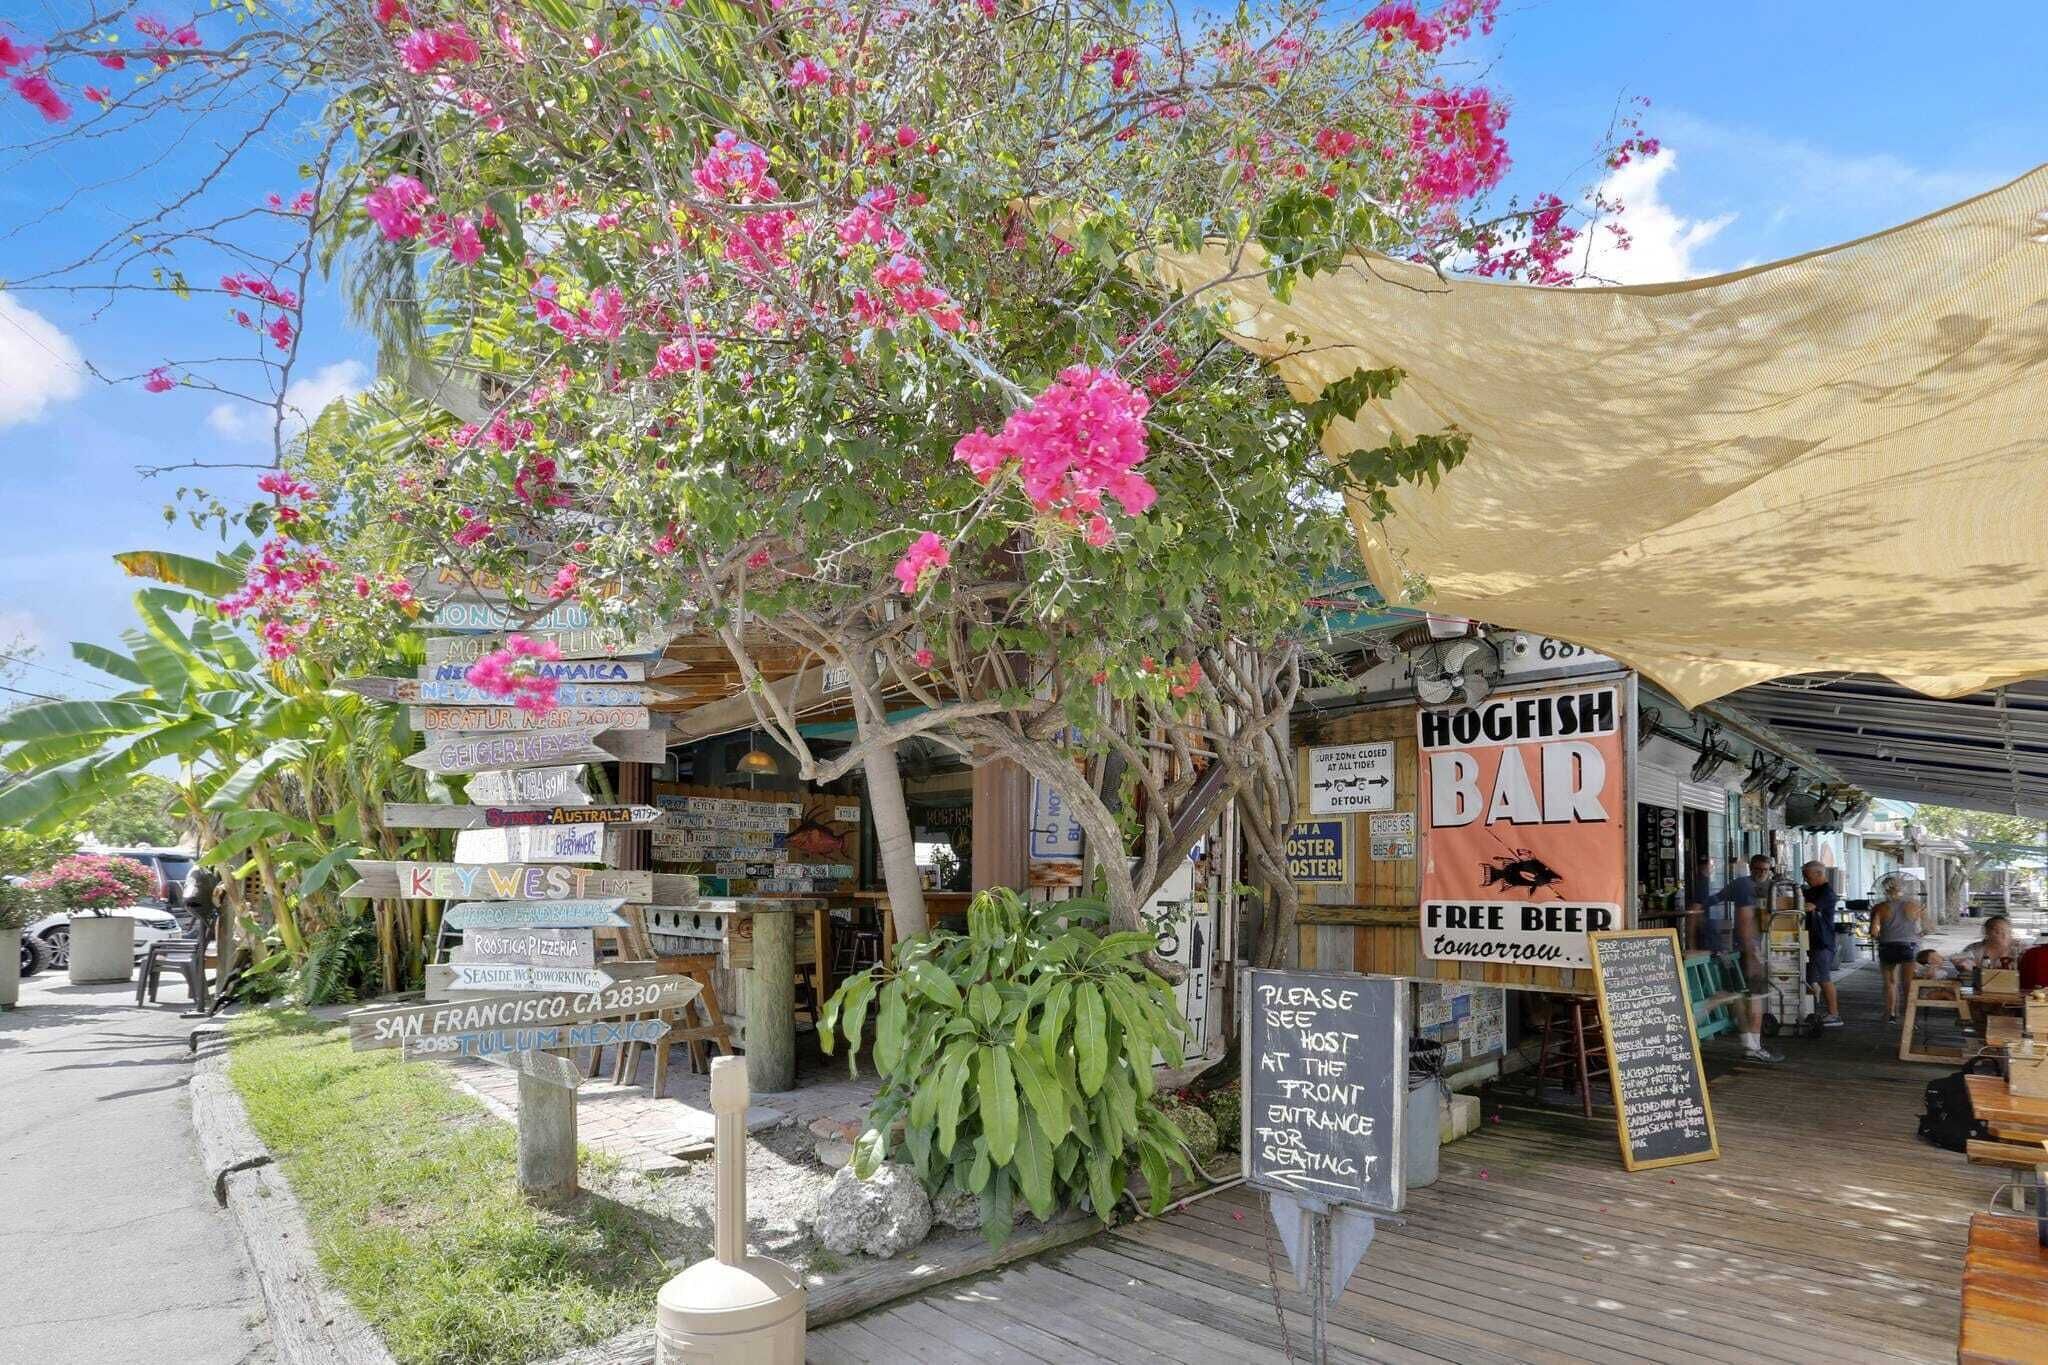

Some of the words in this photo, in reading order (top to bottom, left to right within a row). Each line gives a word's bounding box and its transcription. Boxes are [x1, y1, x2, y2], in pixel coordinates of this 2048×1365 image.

[1421, 690, 1614, 748] HOGFISH
[1316, 753, 1333, 762] URF
[1336, 752, 1356, 761] ZONE
[1359, 749, 1387, 758] CLOSED
[1328, 763, 1336, 772] AT
[1339, 761, 1352, 770] ALL
[1354, 760, 1375, 769] TIDES
[1430, 741, 1610, 829] BAR
[1331, 795, 1371, 807] DETOUR
[552, 807, 631, 825] AUSTRALIA
[1046, 823, 1059, 844] DO
[1312, 823, 1321, 835] A
[1284, 838, 1335, 857] OSTER
[1289, 858, 1343, 877] OSTER!
[410, 866, 481, 898] KEY
[488, 864, 594, 899] WEST
[1427, 905, 1504, 930] FREE
[1521, 907, 1612, 932] BEER
[475, 934, 526, 957] ROOSTICA
[528, 935, 580, 957] PIZZERIA
[464, 967, 512, 985] SEASIDE
[513, 968, 591, 988] WOODWORKING
[1258, 984, 1359, 1011] PLEASE
[374, 1013, 424, 1041] SAN
[573, 989, 602, 1014] CA
[604, 983, 661, 1009] 2830
[1265, 1010, 1317, 1028] SEE
[457, 1026, 560, 1057] TULUM
[568, 1021, 663, 1046] MEXICO
[1300, 1029, 1359, 1054] HOST
[1260, 1052, 1290, 1073] AT
[1300, 1057, 1347, 1077] THE
[1277, 1079, 1365, 1106] FRONT
[1268, 1104, 1375, 1136] ENTRANCE
[1256, 1127, 1306, 1149] FOR
